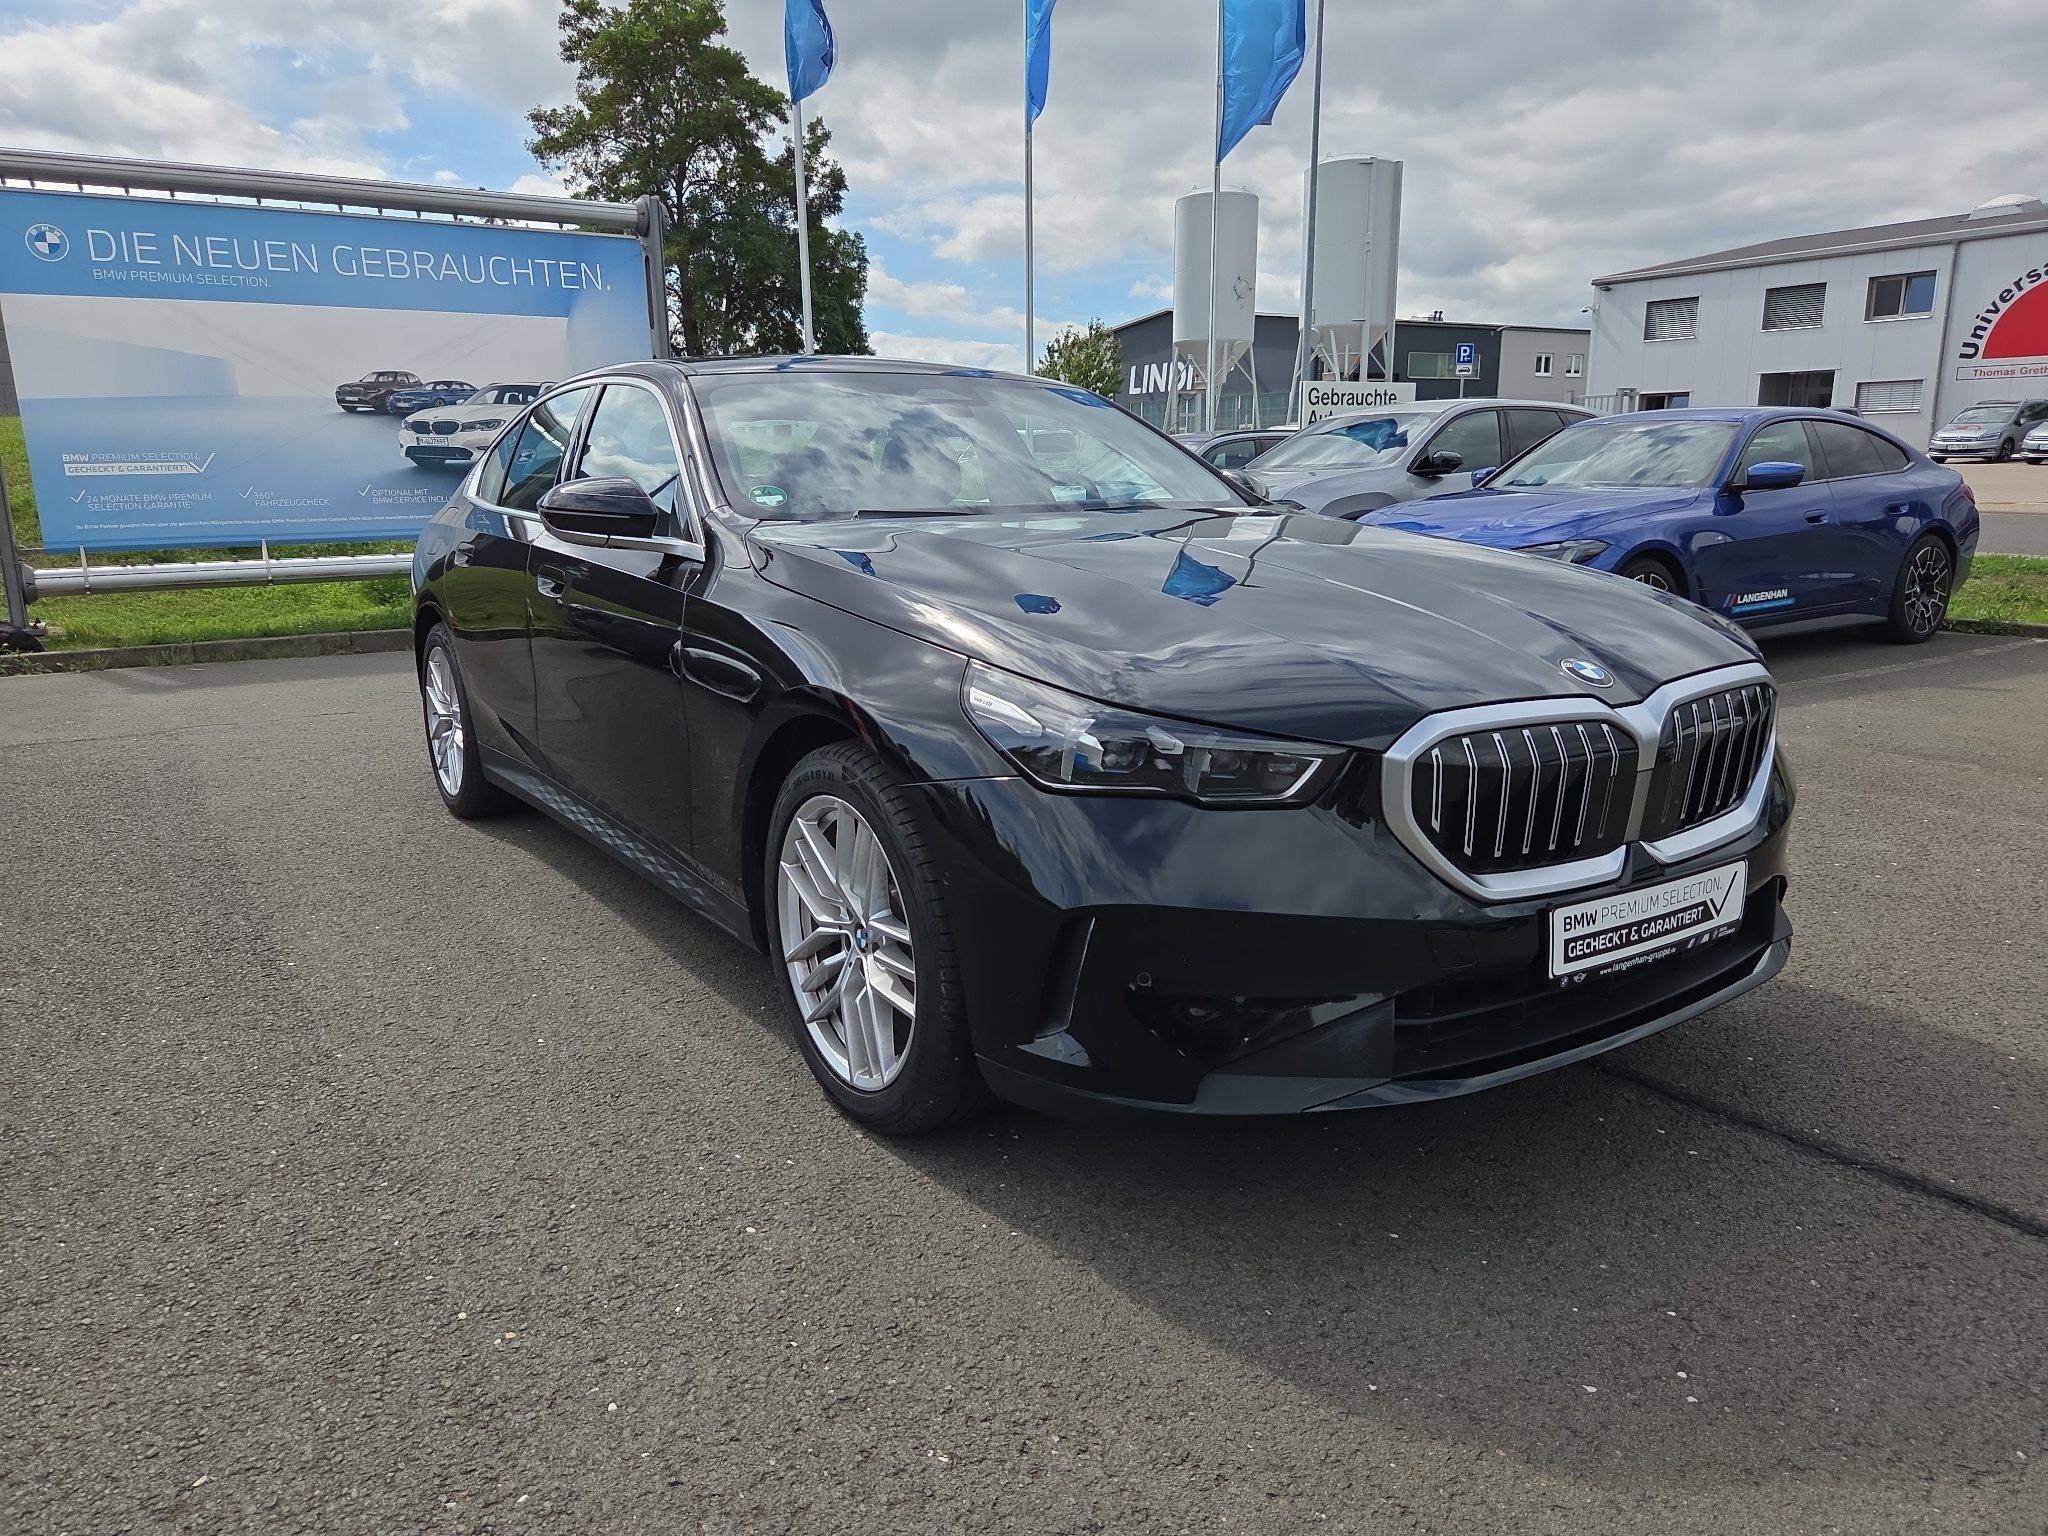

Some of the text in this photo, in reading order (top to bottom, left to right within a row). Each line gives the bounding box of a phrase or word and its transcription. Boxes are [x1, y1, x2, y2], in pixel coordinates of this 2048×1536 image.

[87, 229, 611, 291] DIE NEUEN GEBRAUCHTEN.
[93, 268, 272, 288] BMW PREMIUM SELECTION.
[1460, 346, 1470, 361] P
[1972, 368, 2016, 378] Thomas
[1308, 387, 1397, 406] Gebrauchte
[62, 452, 200, 462] BMW PREMIUM SELECTION.
[68, 465, 115, 474] GECHECKT
[87, 493, 212, 503] 24 MONATE BMW PREMIUM
[372, 488, 428, 497] OPTIONAL MIT
[88, 502, 141, 512] SELECTION
[255, 498, 330, 507] FAHRZEUGCHECK
[1737, 589, 1788, 604] LANGENHAN
[1563, 876, 1722, 933] BMW PREMIUM SELECTION.
[1568, 928, 1629, 958] GECHECKT
[1630, 926, 1639, 941] &
[1641, 906, 1705, 938] GARANTIERT
[1600, 947, 1677, 975] www.langenhan-gruppe.de
